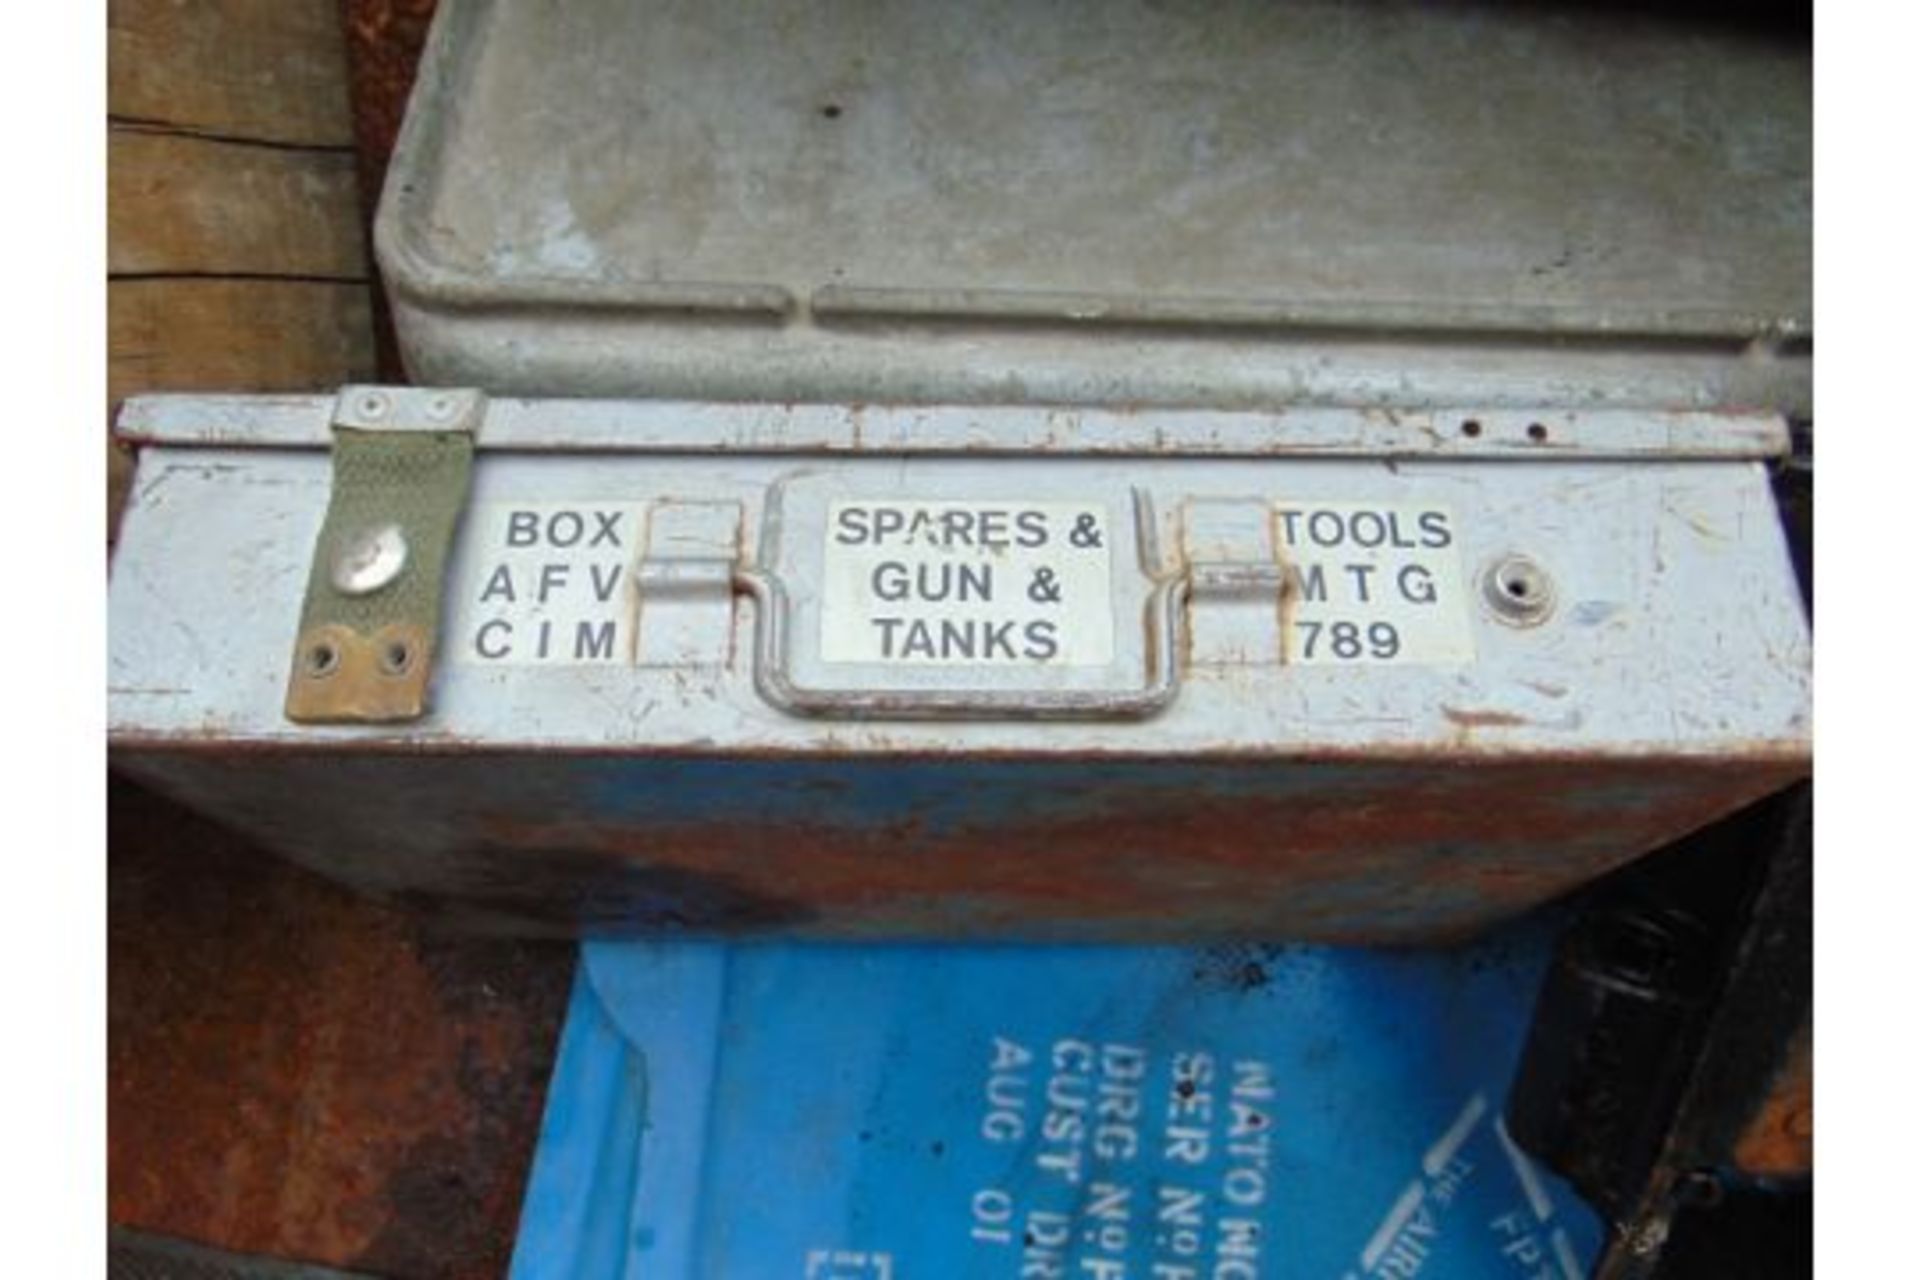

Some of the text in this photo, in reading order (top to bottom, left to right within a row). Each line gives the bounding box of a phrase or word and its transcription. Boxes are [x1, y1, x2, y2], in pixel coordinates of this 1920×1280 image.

[506, 508, 1453, 549] BOX SPARES & TOOLS
[871, 561, 993, 602] GUN
[1027, 566, 1062, 603] &
[871, 617, 1058, 661] TANKS
[1294, 621, 1401, 660] 789
[980, 1036, 1032, 1141] AUG
[1036, 1039, 1094, 1183] CUST
[1094, 1044, 1144, 1160] DRG
[1164, 1053, 1214, 1163] SER
[1223, 1061, 1274, 1206] NATO
